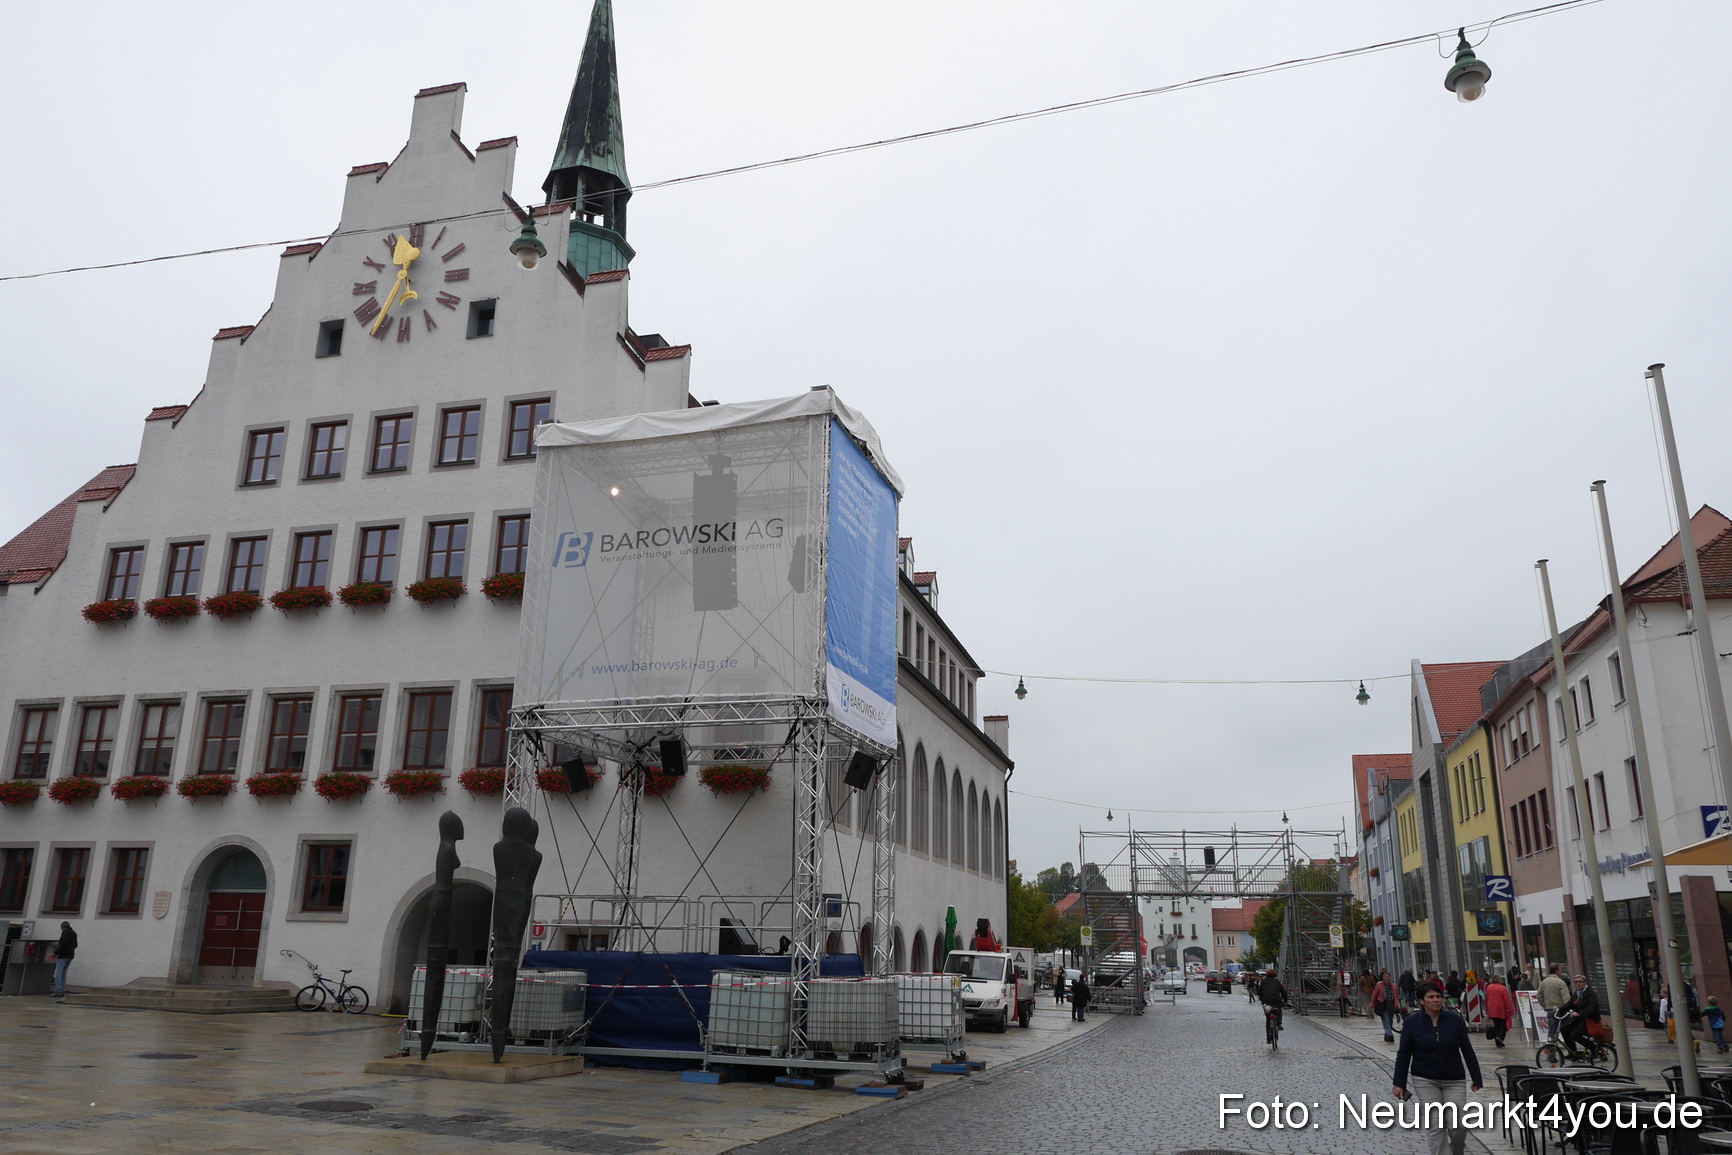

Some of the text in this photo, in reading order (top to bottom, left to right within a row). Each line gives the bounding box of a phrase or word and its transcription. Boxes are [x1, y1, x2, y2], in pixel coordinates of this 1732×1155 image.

[600, 522, 737, 553] BAROWSKI
[744, 518, 784, 540] AG
[599, 542, 782, 563] Veranstaltungs- und Mediensysteme
[591, 656, 738, 674] www.barowski-ag.de
